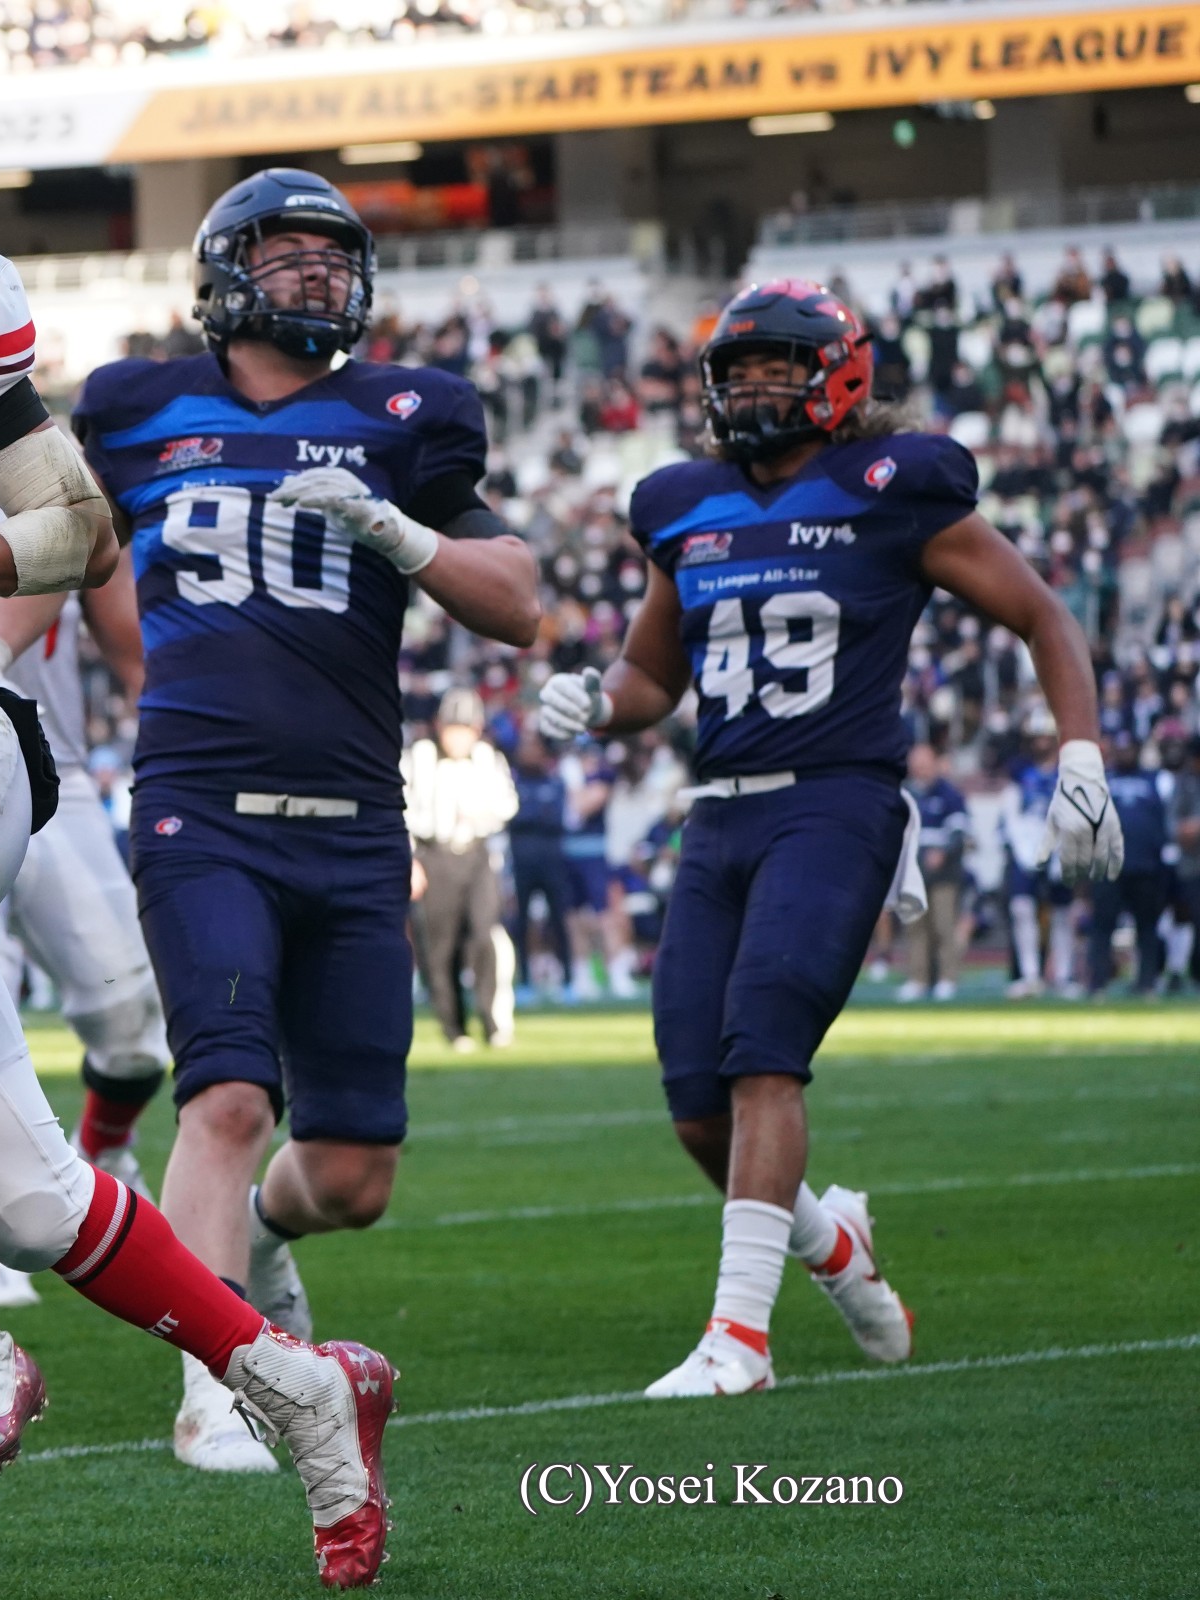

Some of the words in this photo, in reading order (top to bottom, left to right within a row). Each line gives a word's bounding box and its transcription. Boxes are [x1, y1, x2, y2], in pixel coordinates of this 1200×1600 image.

[616, 56, 764, 98] TEAM
[865, 40, 952, 82] IVY
[967, 19, 1189, 75] LEAGUE
[296, 439, 343, 467] Ivy
[161, 484, 356, 614] 90
[787, 521, 833, 550] Ivy
[716, 572, 761, 589] League
[762, 567, 821, 583] All-Star
[700, 590, 841, 722] 49
